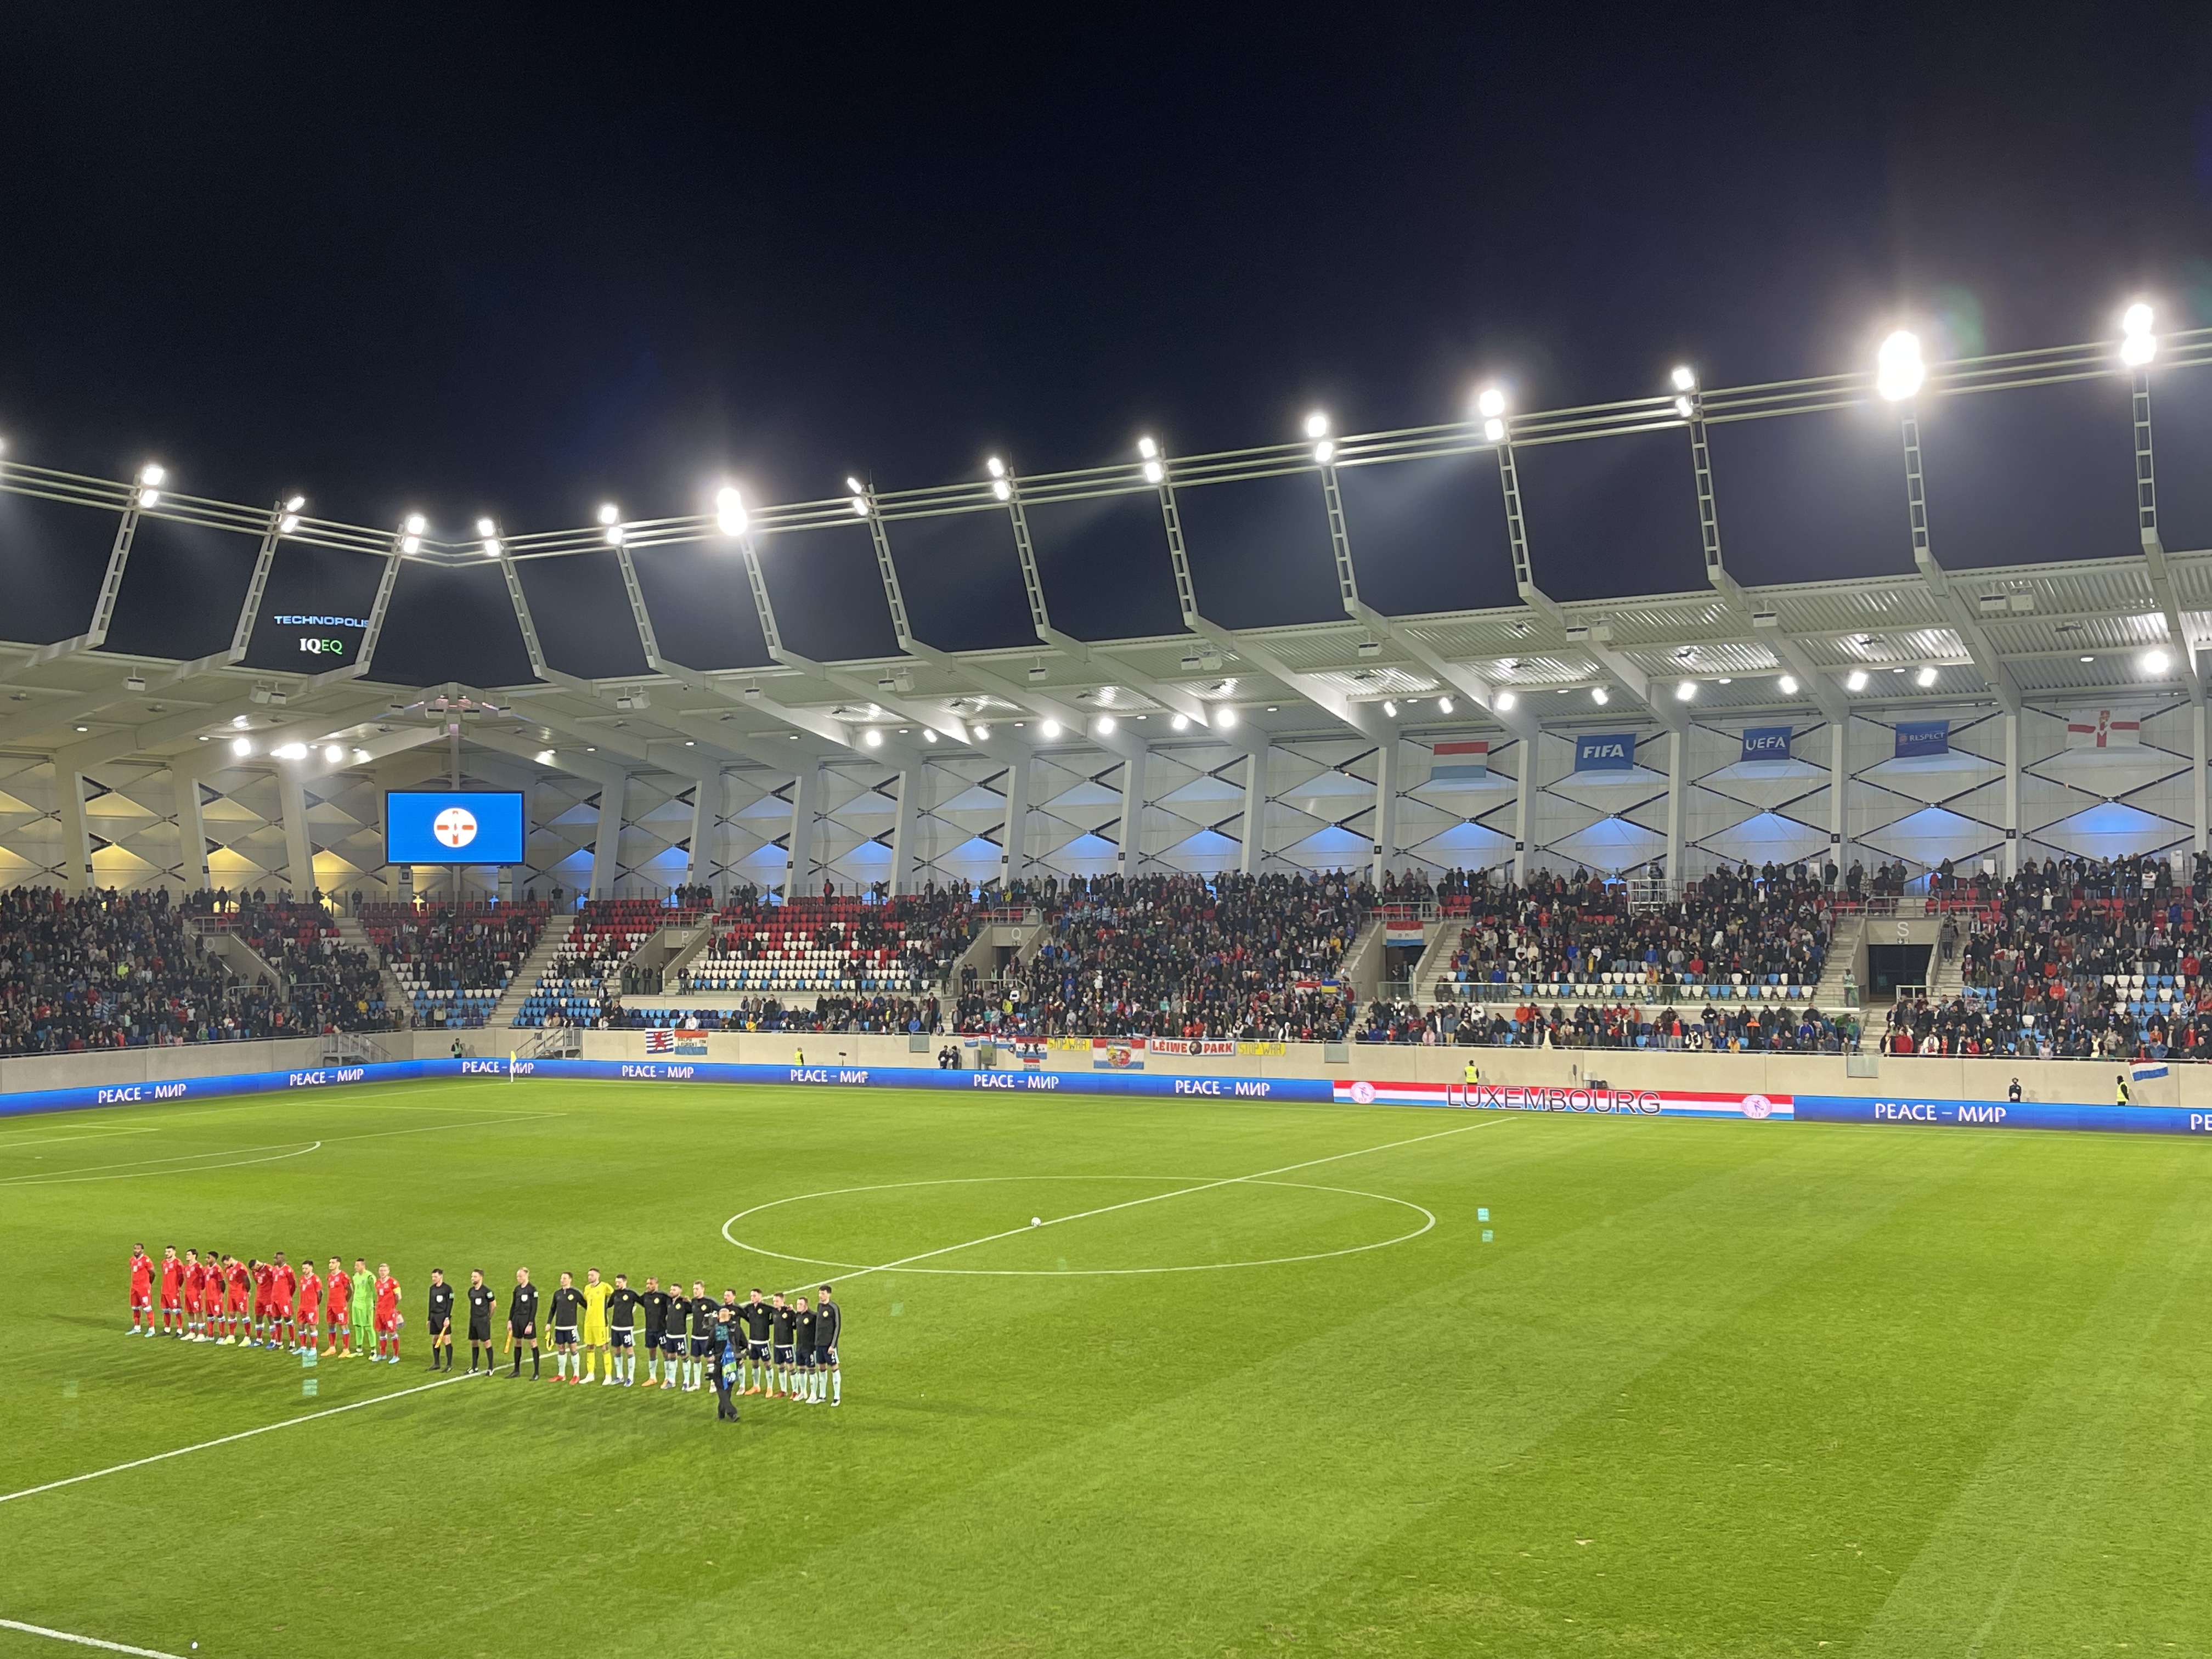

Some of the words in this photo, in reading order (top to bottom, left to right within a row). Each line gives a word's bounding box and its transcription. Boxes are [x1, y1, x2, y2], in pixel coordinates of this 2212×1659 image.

[300, 638, 343, 655] IQEQ
[1745, 736, 1786, 751] UEFA
[1909, 732, 1944, 742] RESPECT
[1583, 743, 1624, 758] FIFA
[681, 930, 689, 941] P
[1011, 928, 1022, 941] Q
[1897, 921, 1910, 937] S
[1204, 1042, 1232, 1053] PARK
[462, 1061, 500, 1074] PEACE
[622, 1065, 657, 1077] PEACE
[290, 1071, 326, 1086] PEACE
[790, 1069, 828, 1082] PEACE
[973, 1074, 1015, 1088] PEACE
[98, 1086, 142, 1104] PEACE
[1175, 1080, 1221, 1095] PEACE
[1446, 1084, 1662, 1115] LUXEMBOURG
[1875, 1103, 1937, 1121] PEACE
